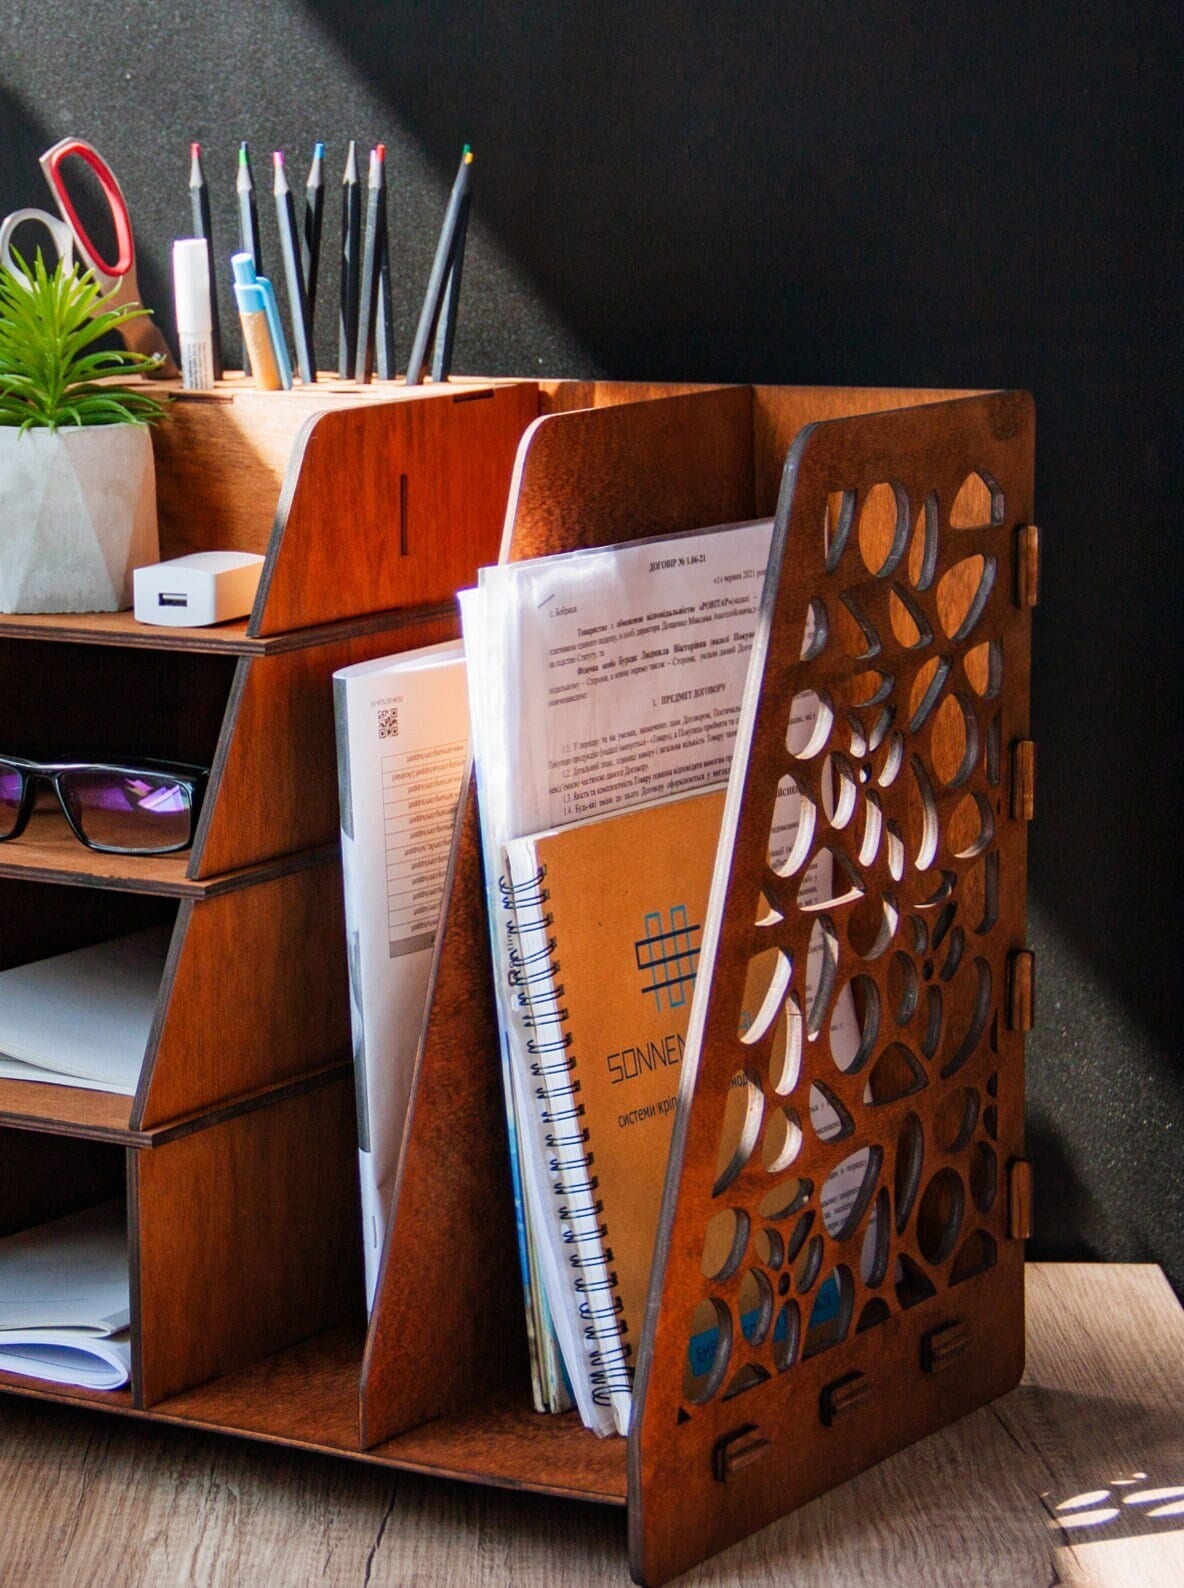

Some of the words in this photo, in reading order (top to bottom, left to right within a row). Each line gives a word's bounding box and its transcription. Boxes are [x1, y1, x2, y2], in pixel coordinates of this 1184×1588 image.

[661, 690, 693, 704] ПРЕДМЕТ
[693, 683, 726, 699] ДОГОВОРУ
[618, 1104, 655, 1128] системи
